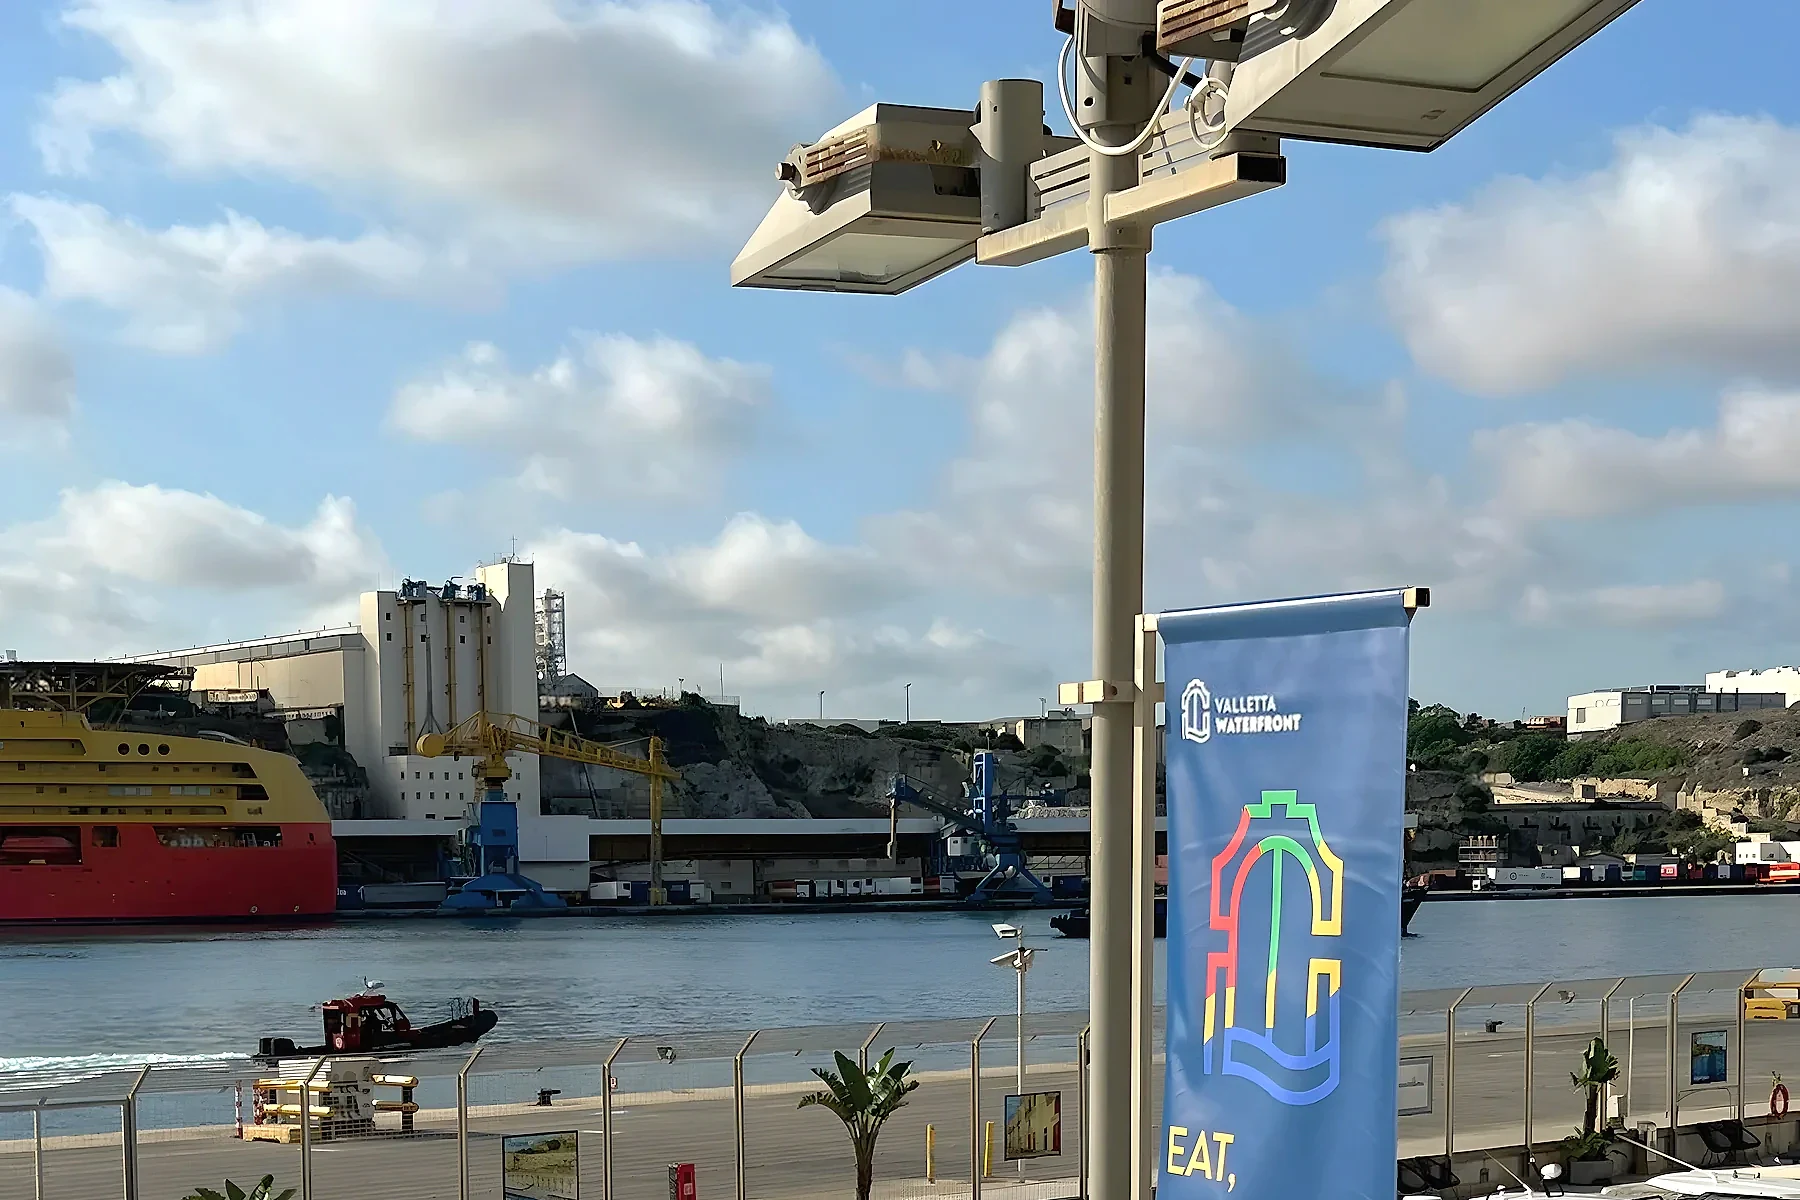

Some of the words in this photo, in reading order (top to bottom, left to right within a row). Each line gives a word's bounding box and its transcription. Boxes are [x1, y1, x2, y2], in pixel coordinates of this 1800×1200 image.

[1215, 695, 1277, 714] VALLETTA
[1215, 713, 1302, 734] WATERFRONT
[1166, 1125, 1236, 1193] EAT,
